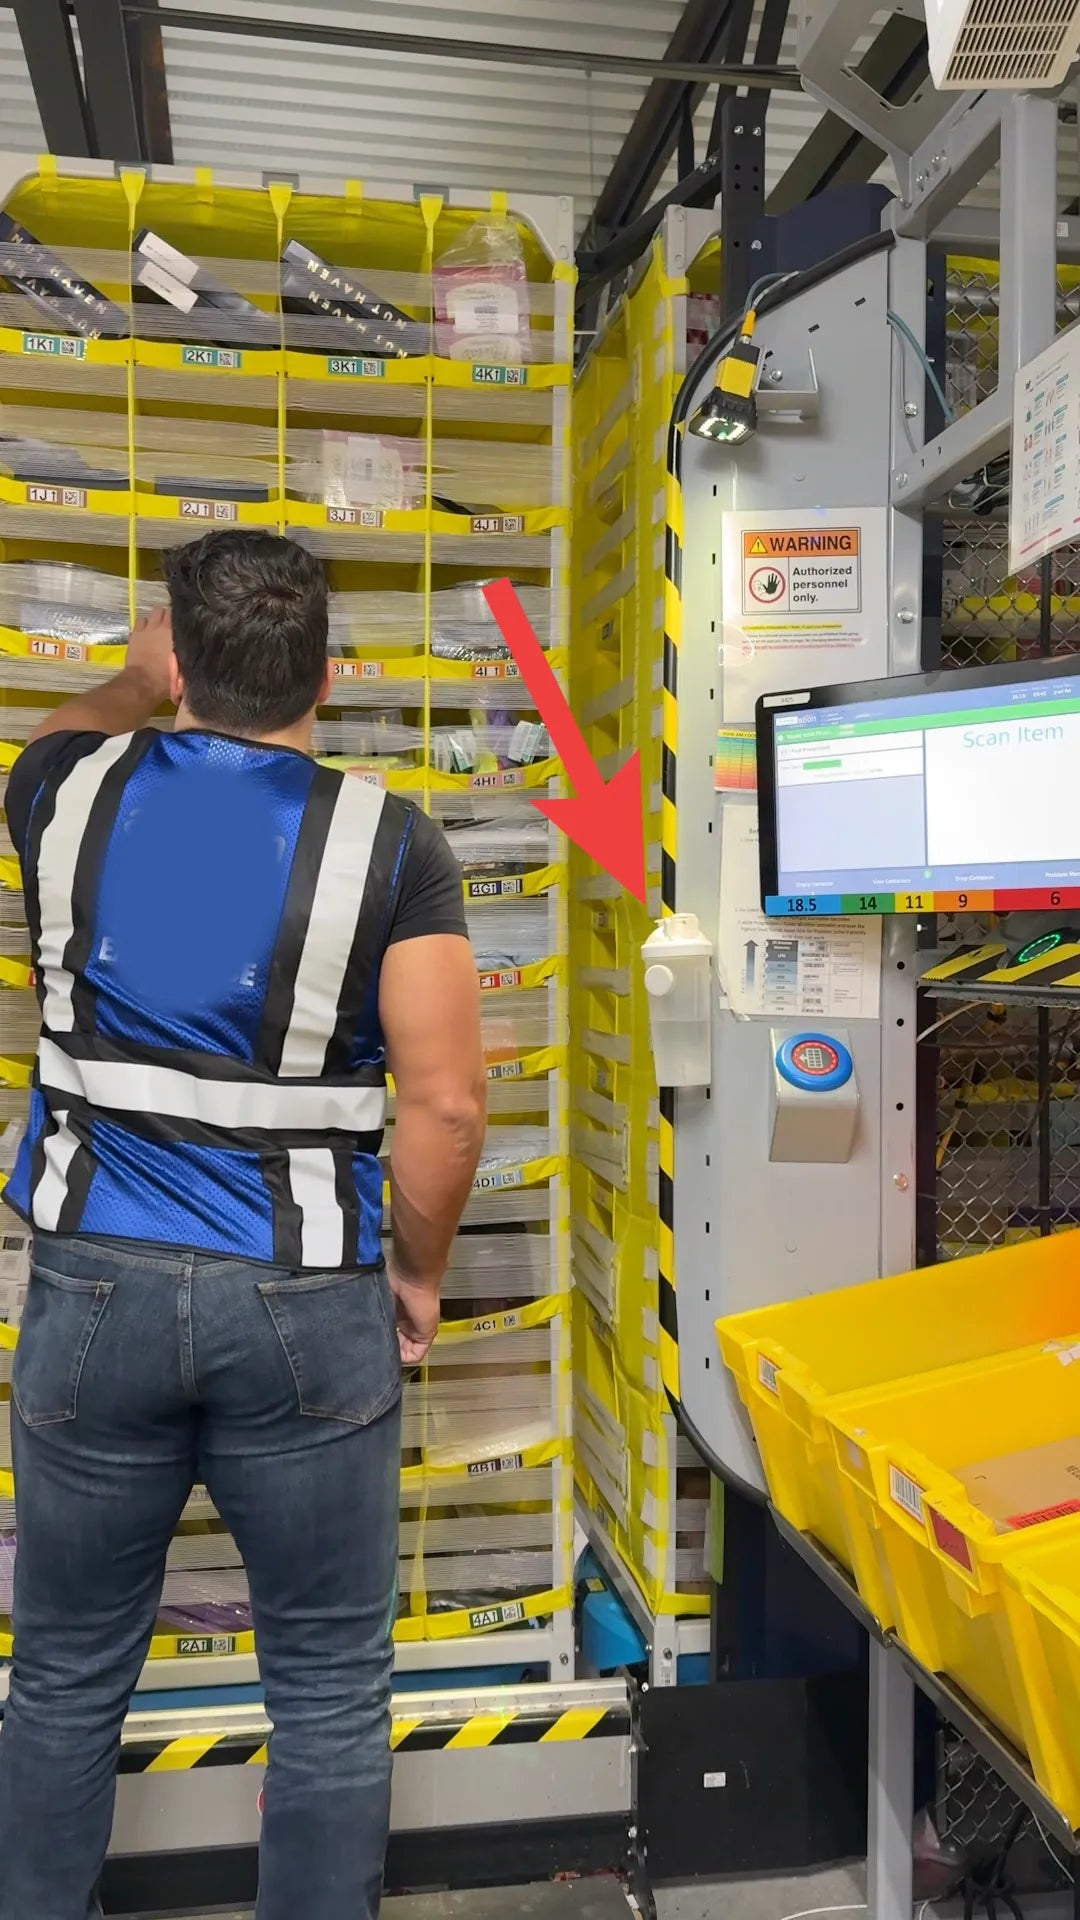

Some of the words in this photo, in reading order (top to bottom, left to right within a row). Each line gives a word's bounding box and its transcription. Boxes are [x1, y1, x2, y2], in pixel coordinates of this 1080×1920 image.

[306, 259, 367, 305] HAVEN
[370, 304, 408, 331] NUT
[372, 334, 408, 359] NUT
[769, 535, 852, 552] WARNING
[793, 566, 852, 576] Authorized
[793, 579, 848, 591] personnel
[793, 593, 818, 604] only.
[963, 731, 1010, 748] Scan
[1018, 726, 1064, 743] Item
[787, 898, 817, 912] 18.5
[859, 896, 877, 910] 14
[905, 895, 924, 909] 11
[958, 894, 968, 908] 9
[1050, 891, 1061, 906] 6
